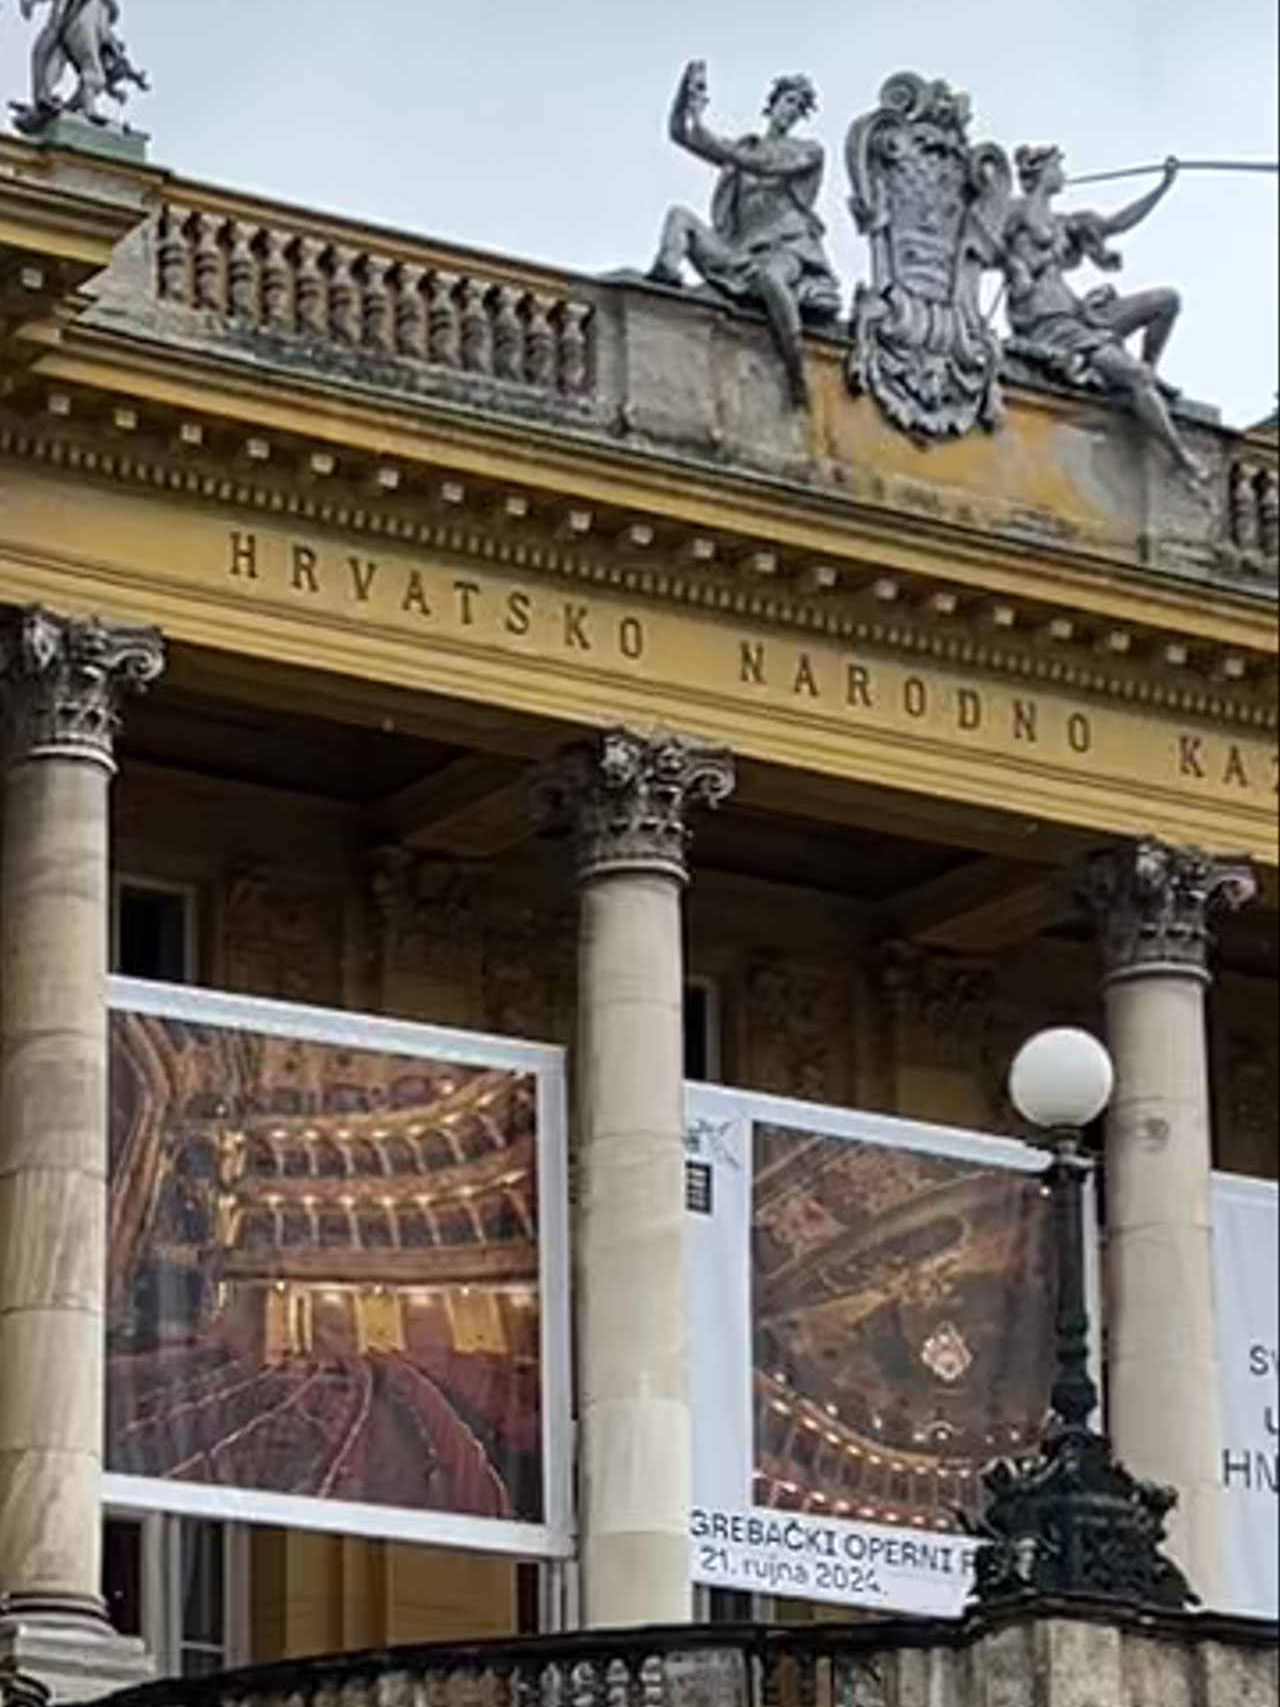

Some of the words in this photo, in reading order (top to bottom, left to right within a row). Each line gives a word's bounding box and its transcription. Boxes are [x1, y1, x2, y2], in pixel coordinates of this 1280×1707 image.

[228, 531, 644, 660] HRVATSKO
[739, 640, 1093, 754] NARODNO
[1177, 735, 1279, 792] KA
[700, 1546, 737, 1575] 21.
[743, 1556, 810, 1586] rujna
[816, 1562, 889, 1596] 2024.
[843, 1534, 953, 1574] OPERNI
